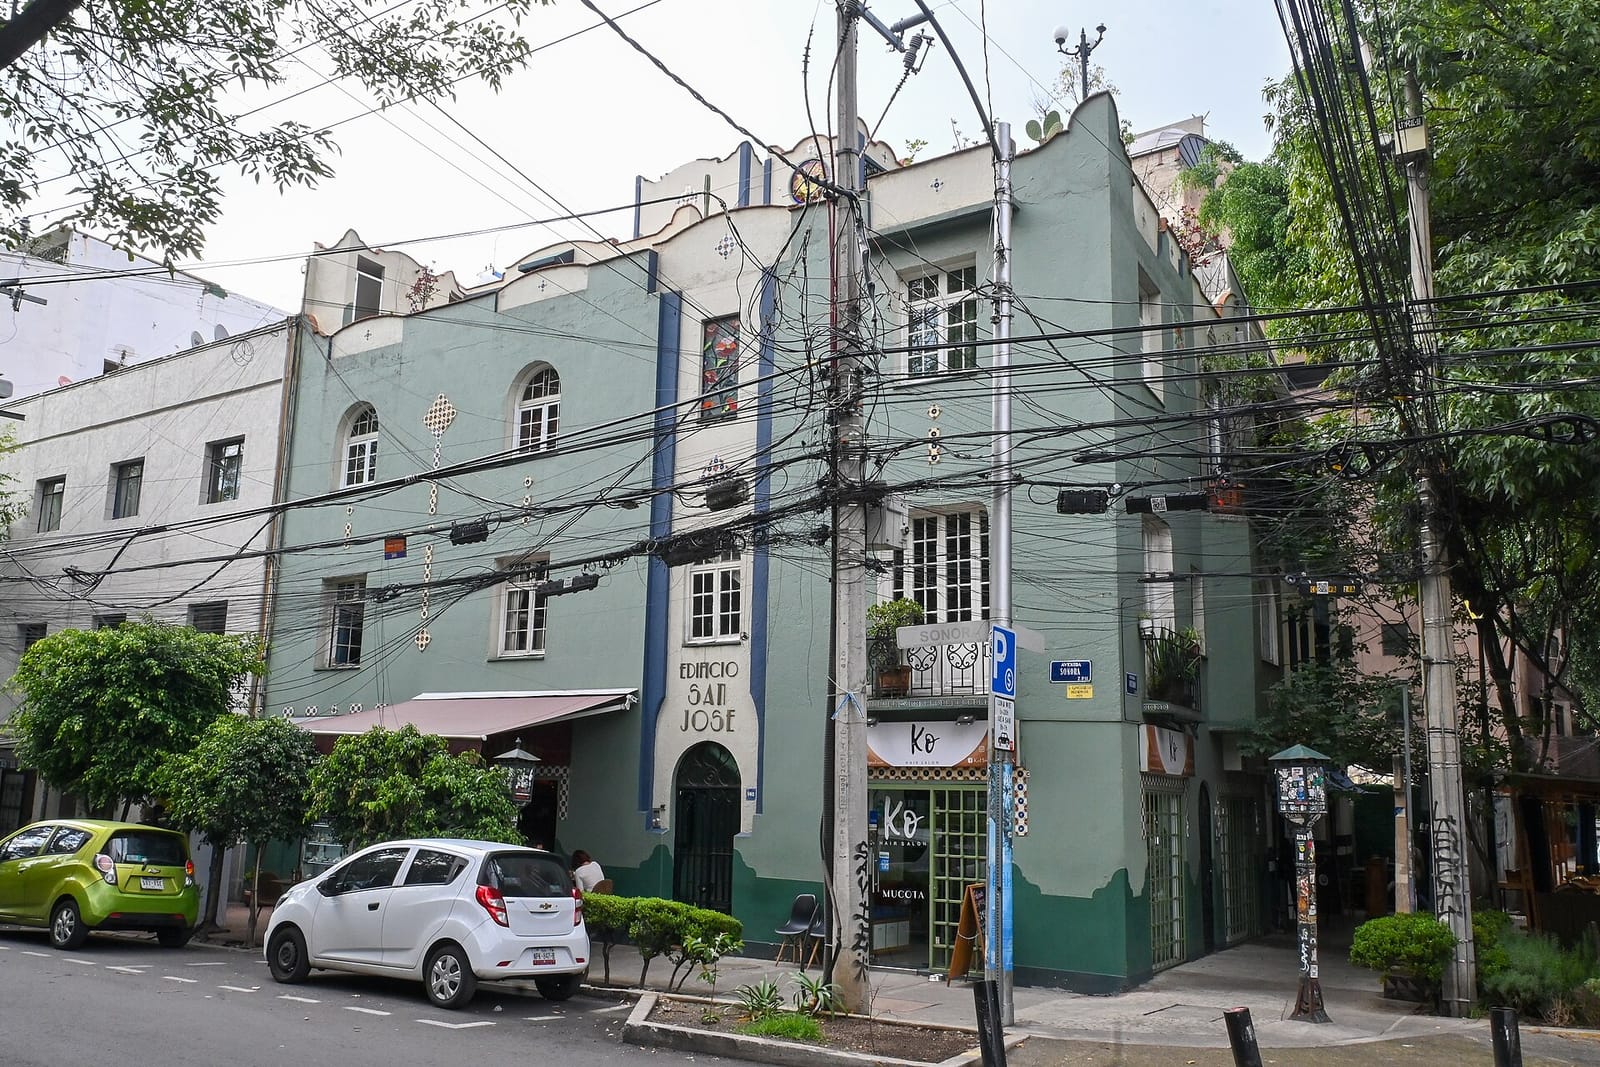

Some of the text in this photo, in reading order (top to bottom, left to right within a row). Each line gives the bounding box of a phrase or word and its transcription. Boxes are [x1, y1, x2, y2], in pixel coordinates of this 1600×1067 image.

[920, 627, 982, 642] SONORA
[993, 630, 1007, 679] P
[680, 661, 739, 679] EDIFICIO
[1060, 668, 1081, 676] SONORA
[688, 683, 726, 706] SAN
[680, 709, 736, 732] JOSE
[883, 890, 925, 899] MUCOTA
